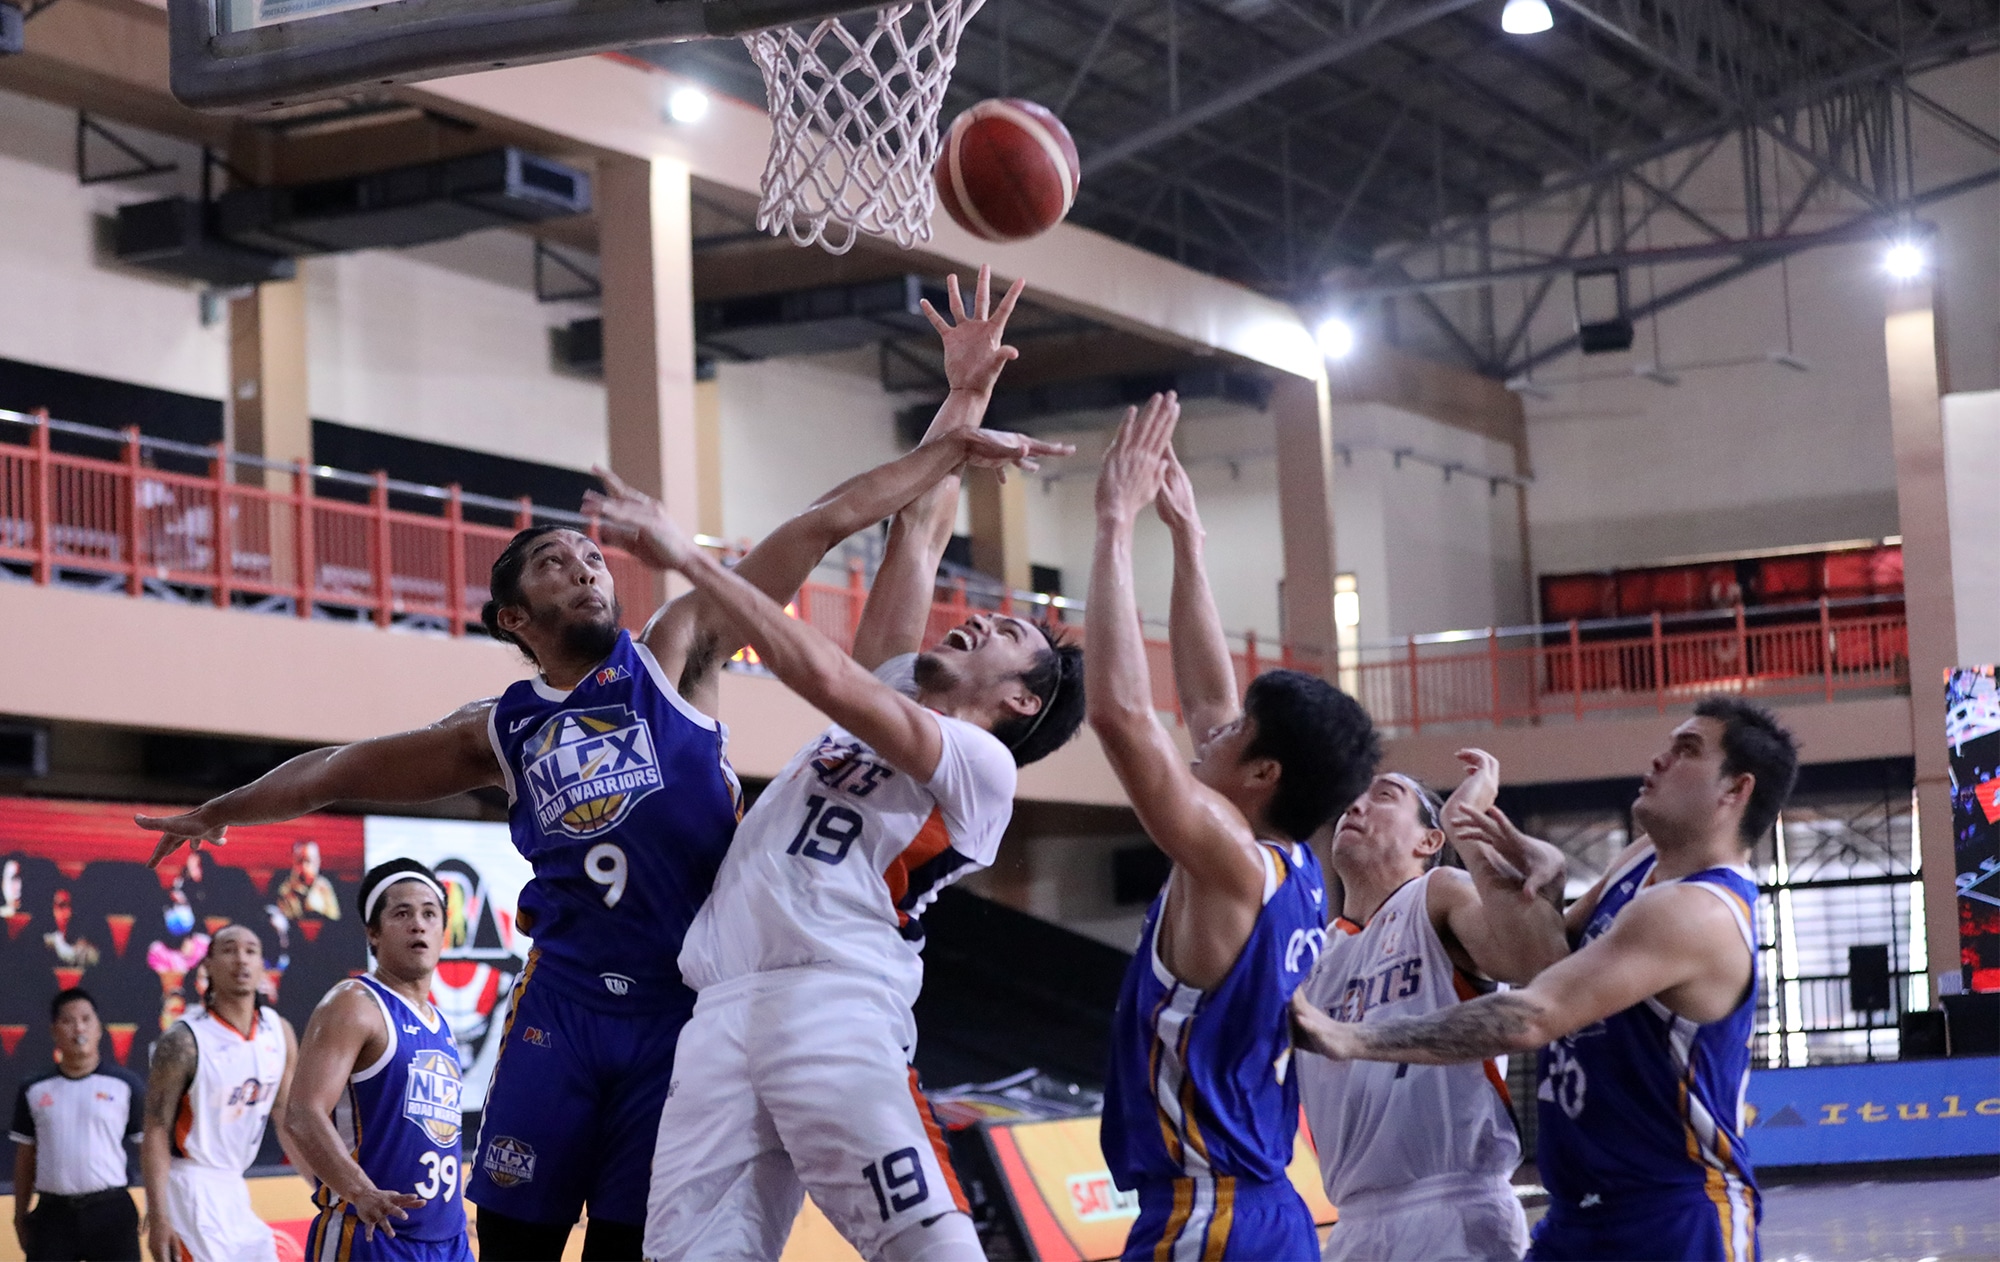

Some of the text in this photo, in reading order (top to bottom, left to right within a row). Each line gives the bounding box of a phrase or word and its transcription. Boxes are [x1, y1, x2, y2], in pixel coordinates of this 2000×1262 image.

[528, 728, 649, 804] NLEX
[539, 767, 659, 829] ROAD WARRIORS
[786, 794, 863, 866] 19
[584, 843, 628, 909] 9
[411, 1071, 463, 1108] NLEX
[414, 1151, 457, 1203] 39
[487, 1146, 532, 1171] NLEX
[861, 1146, 929, 1223] 19
